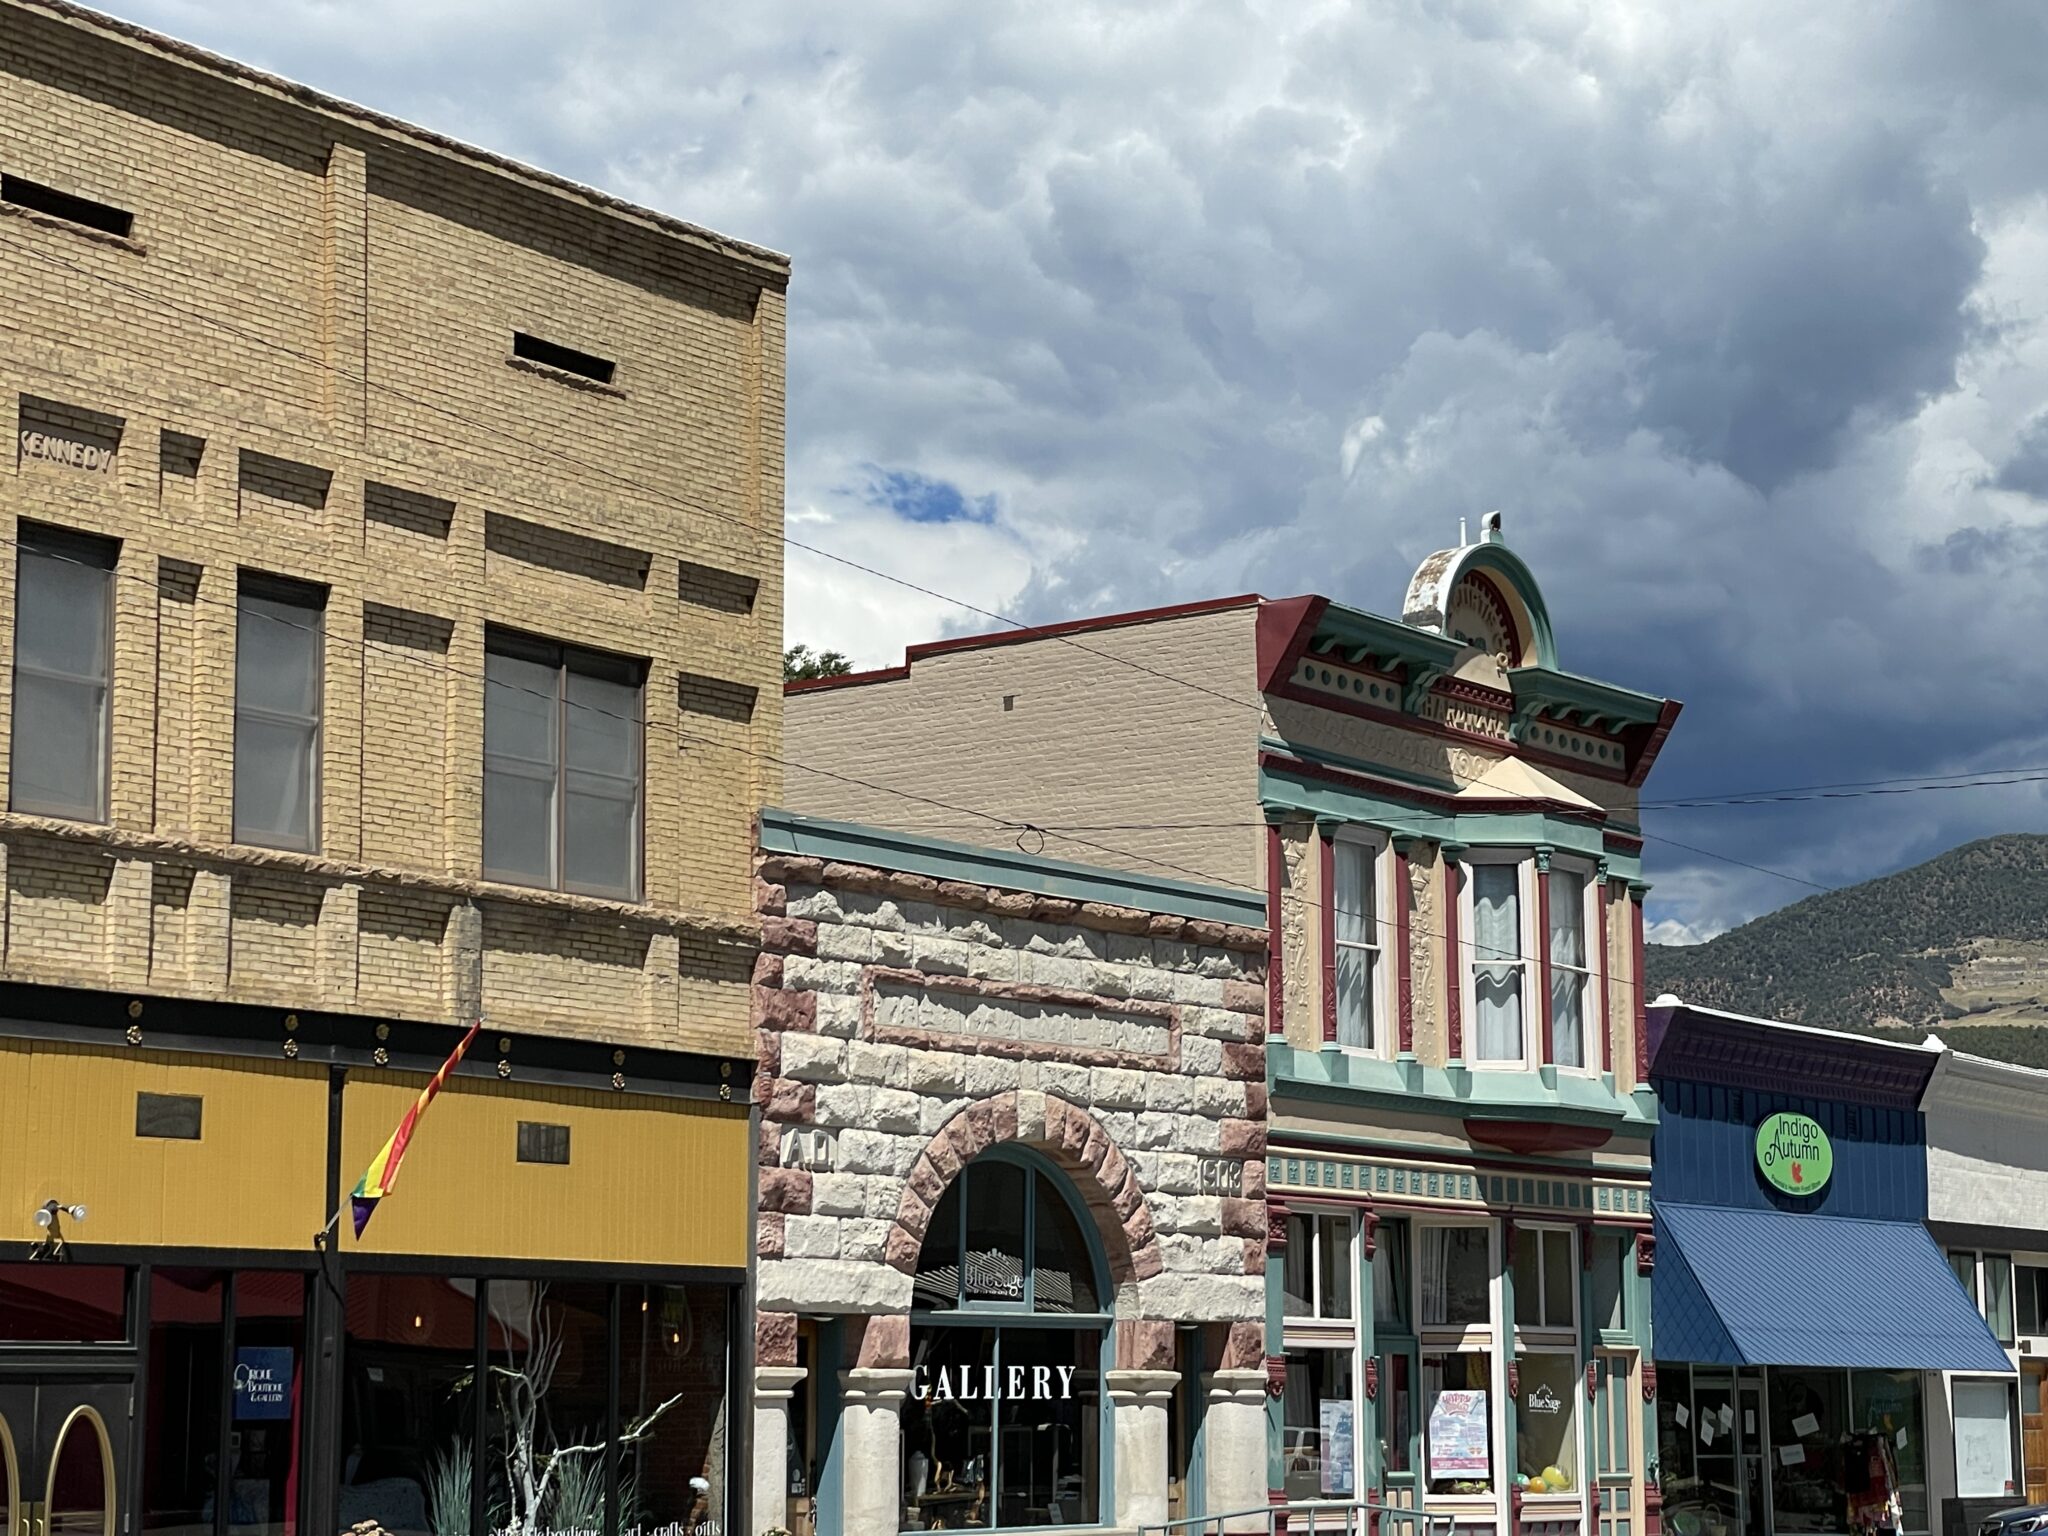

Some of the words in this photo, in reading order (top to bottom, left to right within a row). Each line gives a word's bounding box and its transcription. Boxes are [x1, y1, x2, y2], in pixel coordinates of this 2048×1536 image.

[21, 430, 112, 473] KENNEDY
[1779, 1115, 1819, 1143] Indigo
[1765, 1129, 1820, 1167] Autumn
[909, 1365, 1076, 1400] GALLERY
